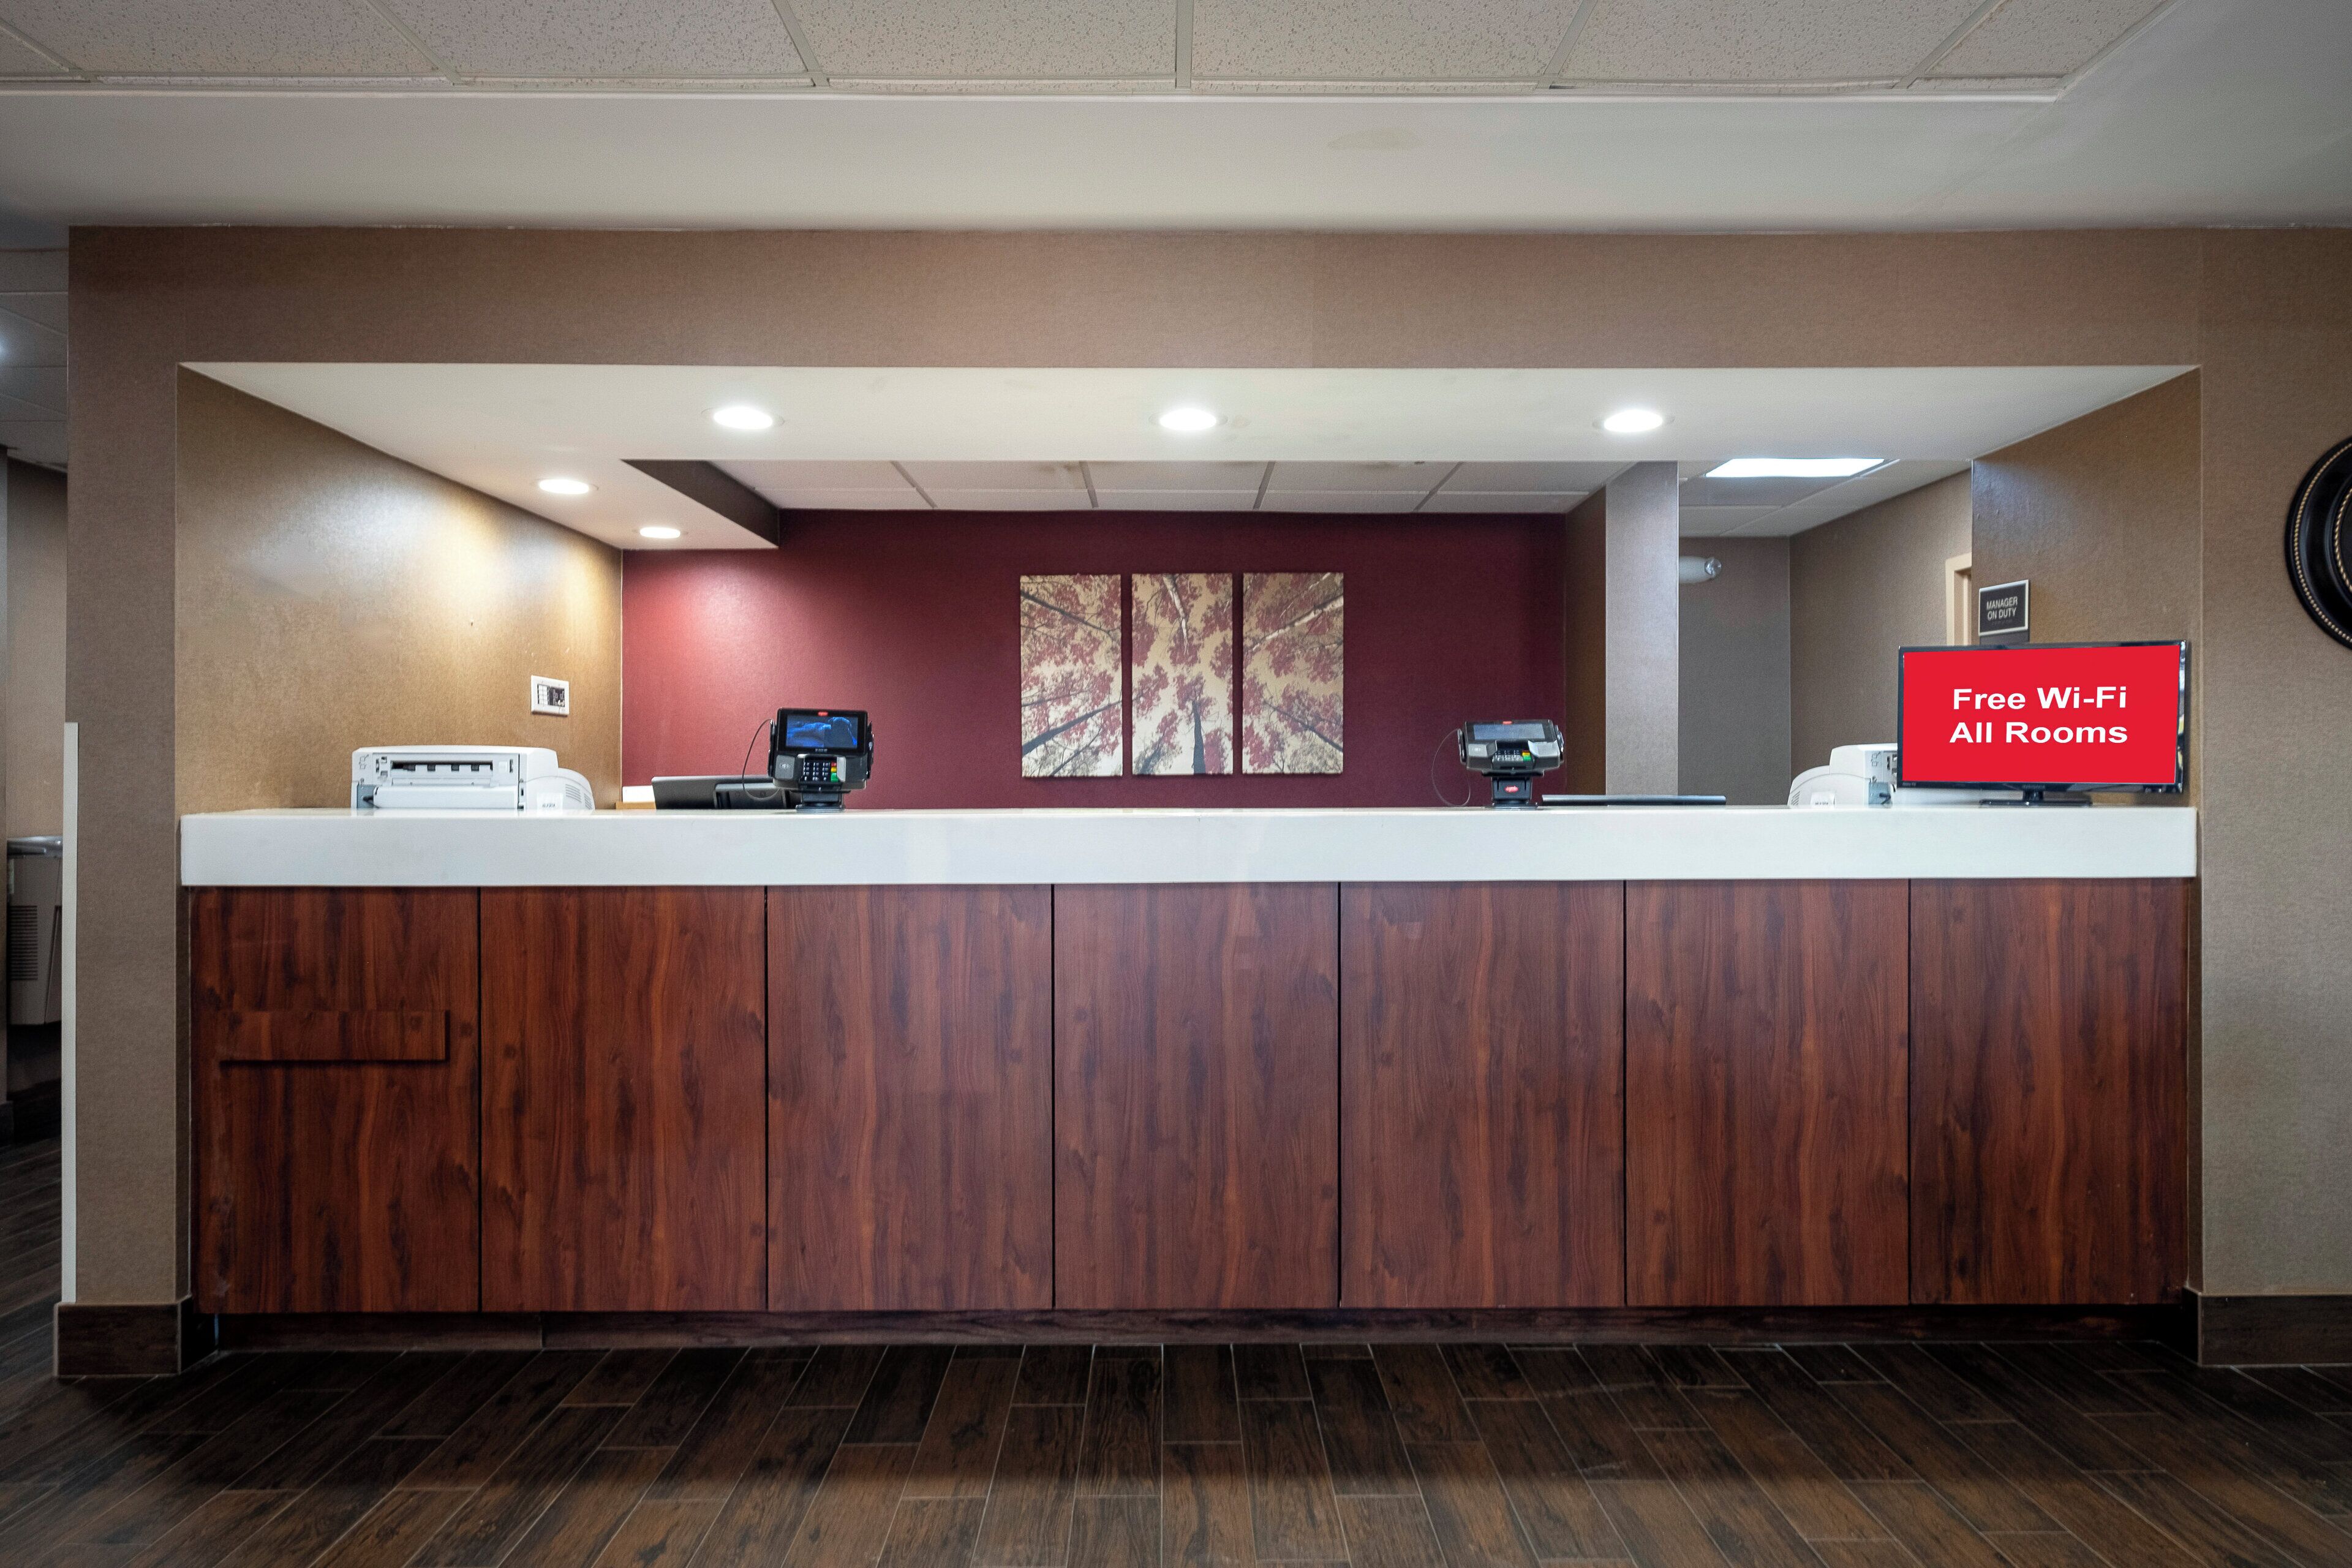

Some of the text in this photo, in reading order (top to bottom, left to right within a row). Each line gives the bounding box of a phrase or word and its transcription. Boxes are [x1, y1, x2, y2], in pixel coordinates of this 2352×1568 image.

[1986, 596, 2018, 610] MANAGER
[1988, 607, 2016, 621] ON DUTY
[1954, 687, 2126, 709] Free Wi-Fi
[1950, 722, 2127, 743] All Rooms
